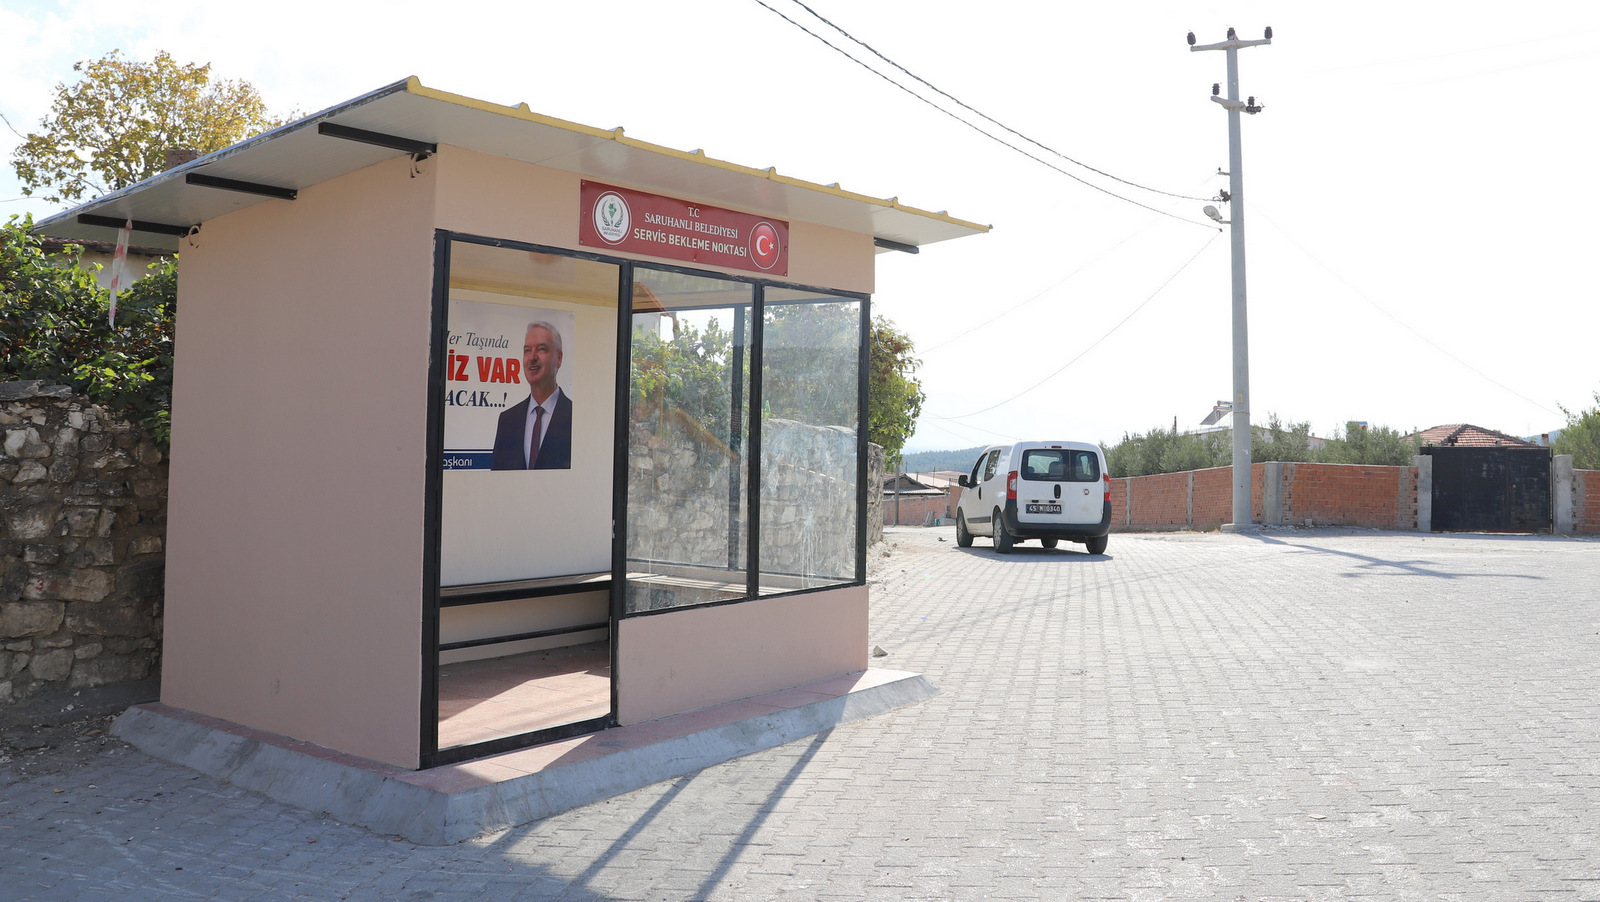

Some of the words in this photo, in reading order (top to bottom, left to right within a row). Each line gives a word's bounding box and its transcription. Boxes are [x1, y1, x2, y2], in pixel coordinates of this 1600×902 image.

[644, 212, 693, 231] SARUHANLI
[694, 221, 738, 239] BELEDİYESİ
[633, 228, 667, 244] SERVİS
[668, 234, 710, 251] BEKLEME
[712, 241, 747, 257] NOKTASI
[466, 332, 509, 350] Taşında
[477, 356, 521, 384] VAR
